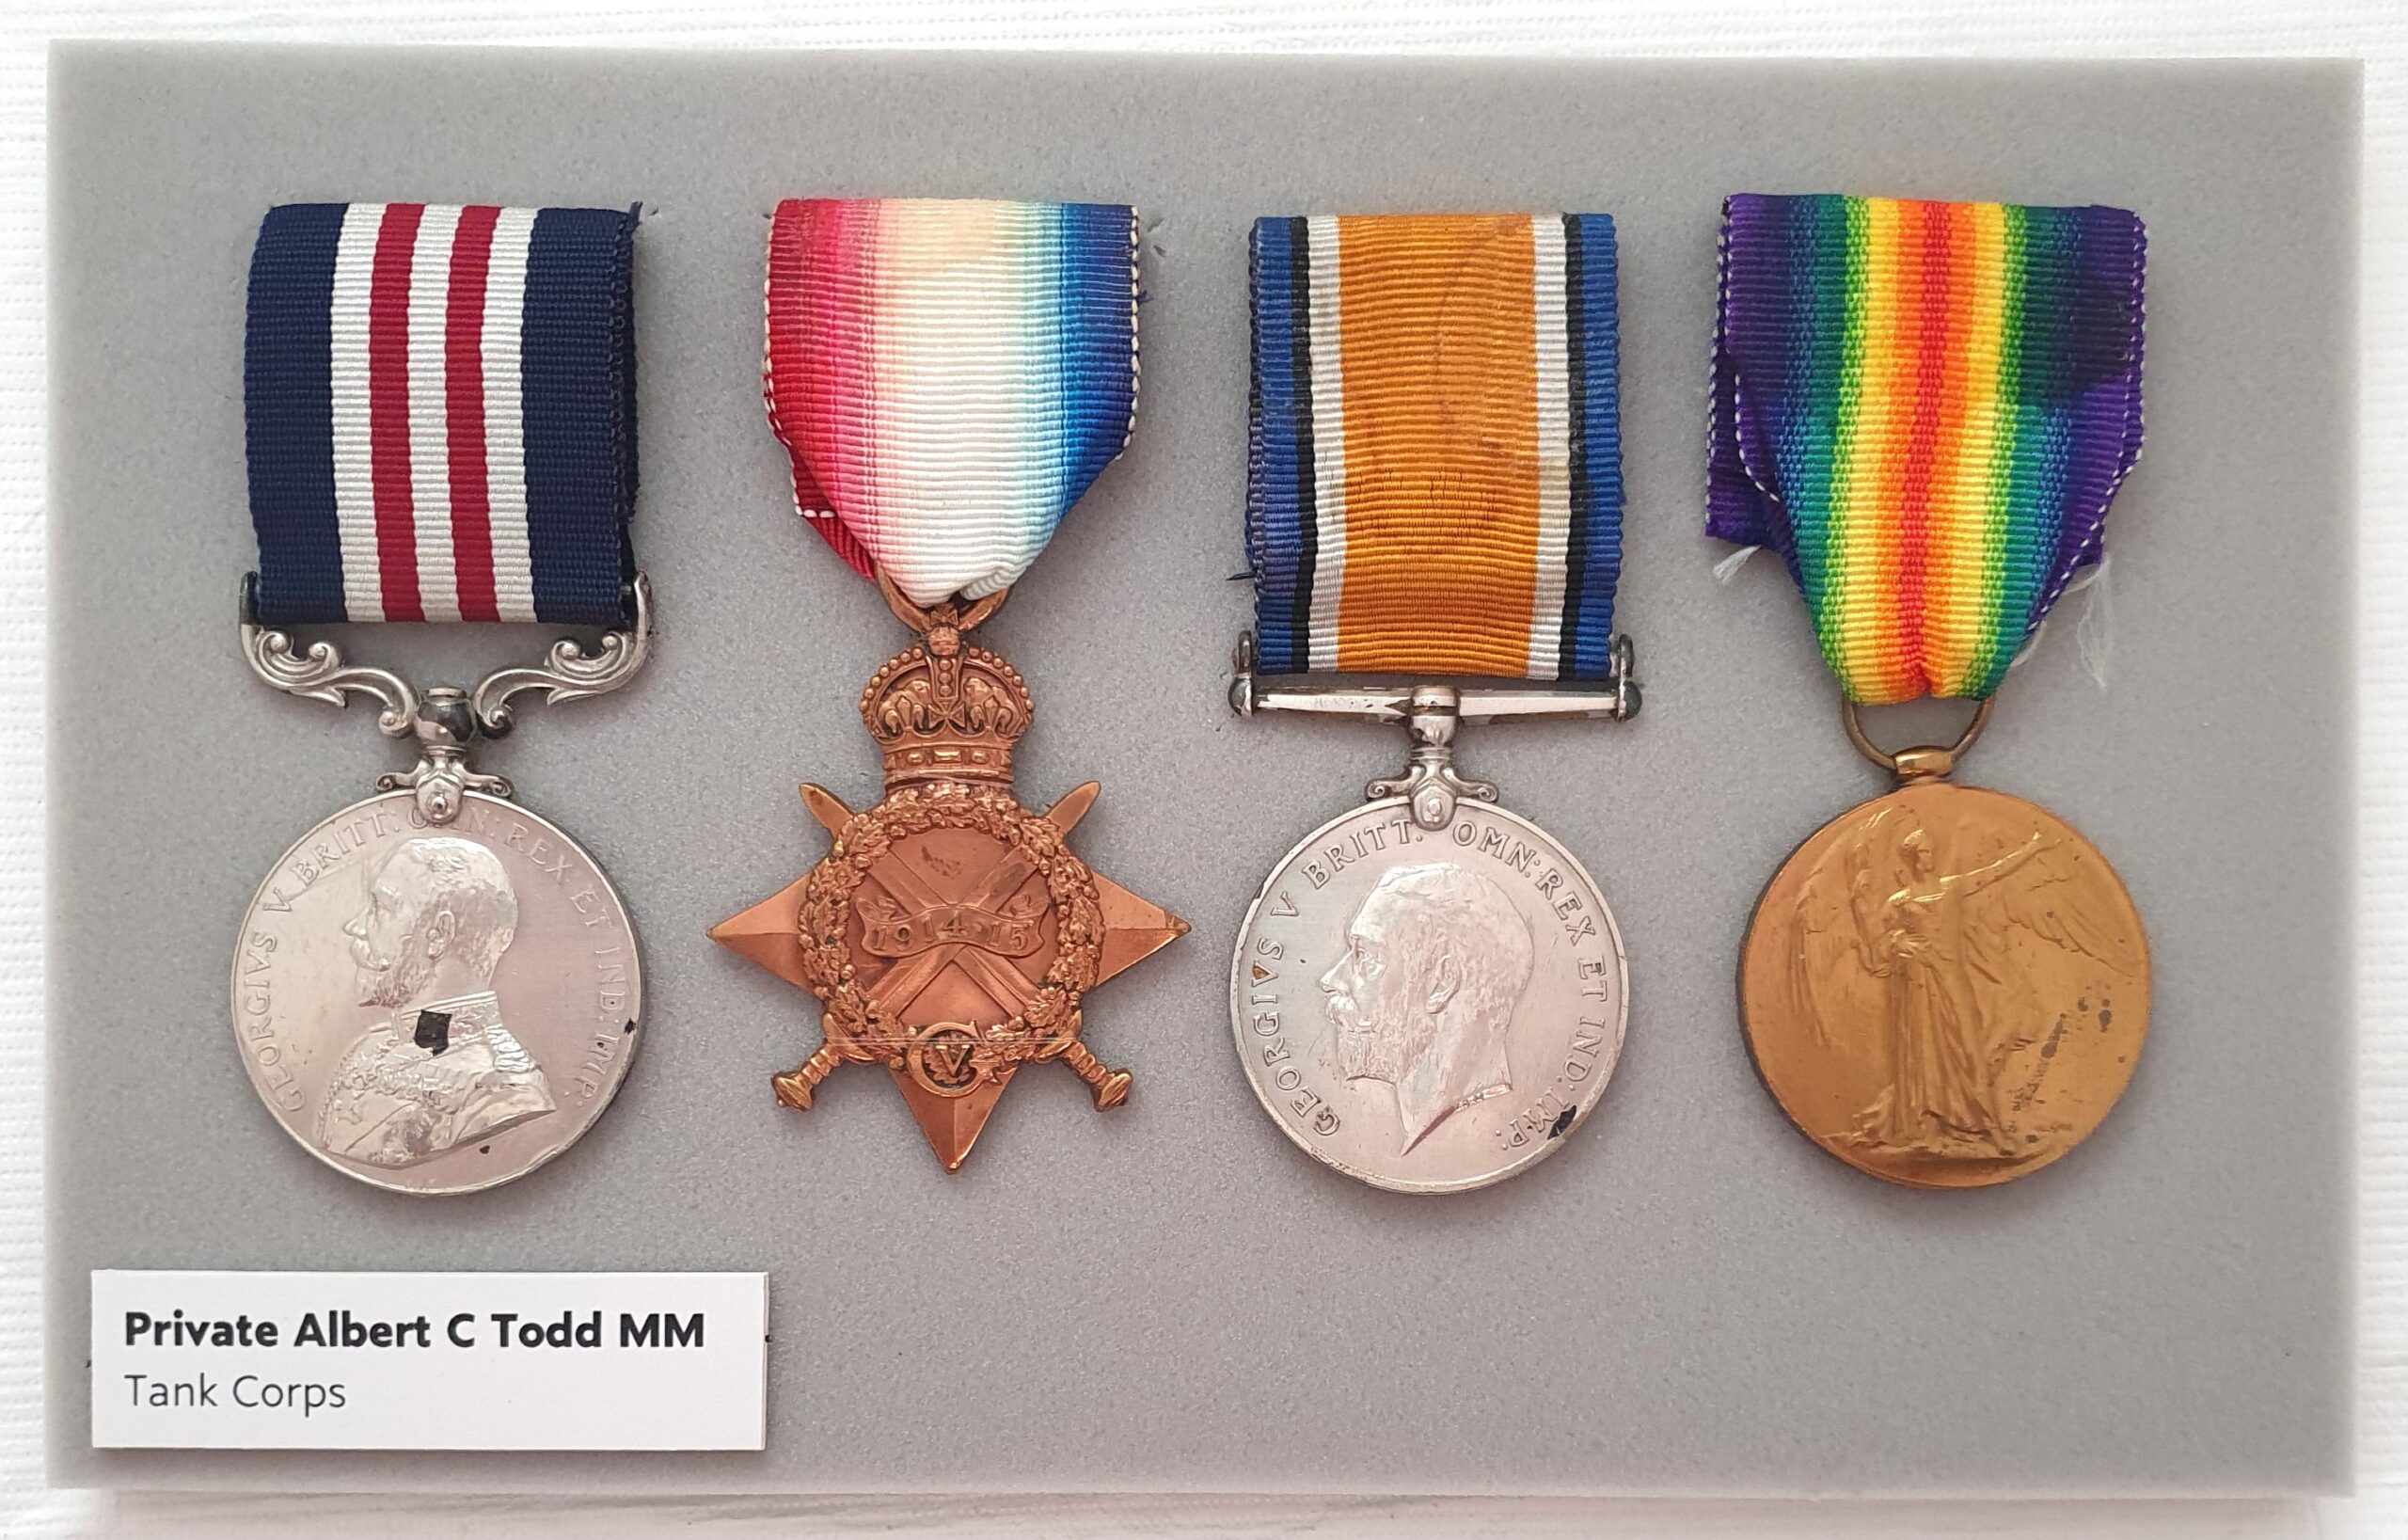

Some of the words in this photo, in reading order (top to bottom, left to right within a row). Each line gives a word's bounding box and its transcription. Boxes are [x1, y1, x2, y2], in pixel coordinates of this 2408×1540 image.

[405, 805, 502, 838] ON:
[503, 821, 574, 886] REX
[1451, 819, 1542, 879] OMN:
[261, 887, 293, 914] V
[570, 890, 612, 929] ET
[1270, 890, 1300, 920] V
[1533, 867, 1597, 947] REX
[1576, 953, 1608, 1005] ET
[245, 930, 307, 1114] GEORGIVS
[1250, 937, 1341, 1136] GEORGIVS
[1556, 1015, 1607, 1092] IND:
[125, 1309, 278, 1347] Private
[293, 1310, 431, 1348] Albert
[447, 1312, 475, 1348] C
[490, 1310, 602, 1348] Todd
[620, 1312, 705, 1348] MM
[124, 1372, 217, 1407] Tank
[232, 1374, 347, 1418] Corps
